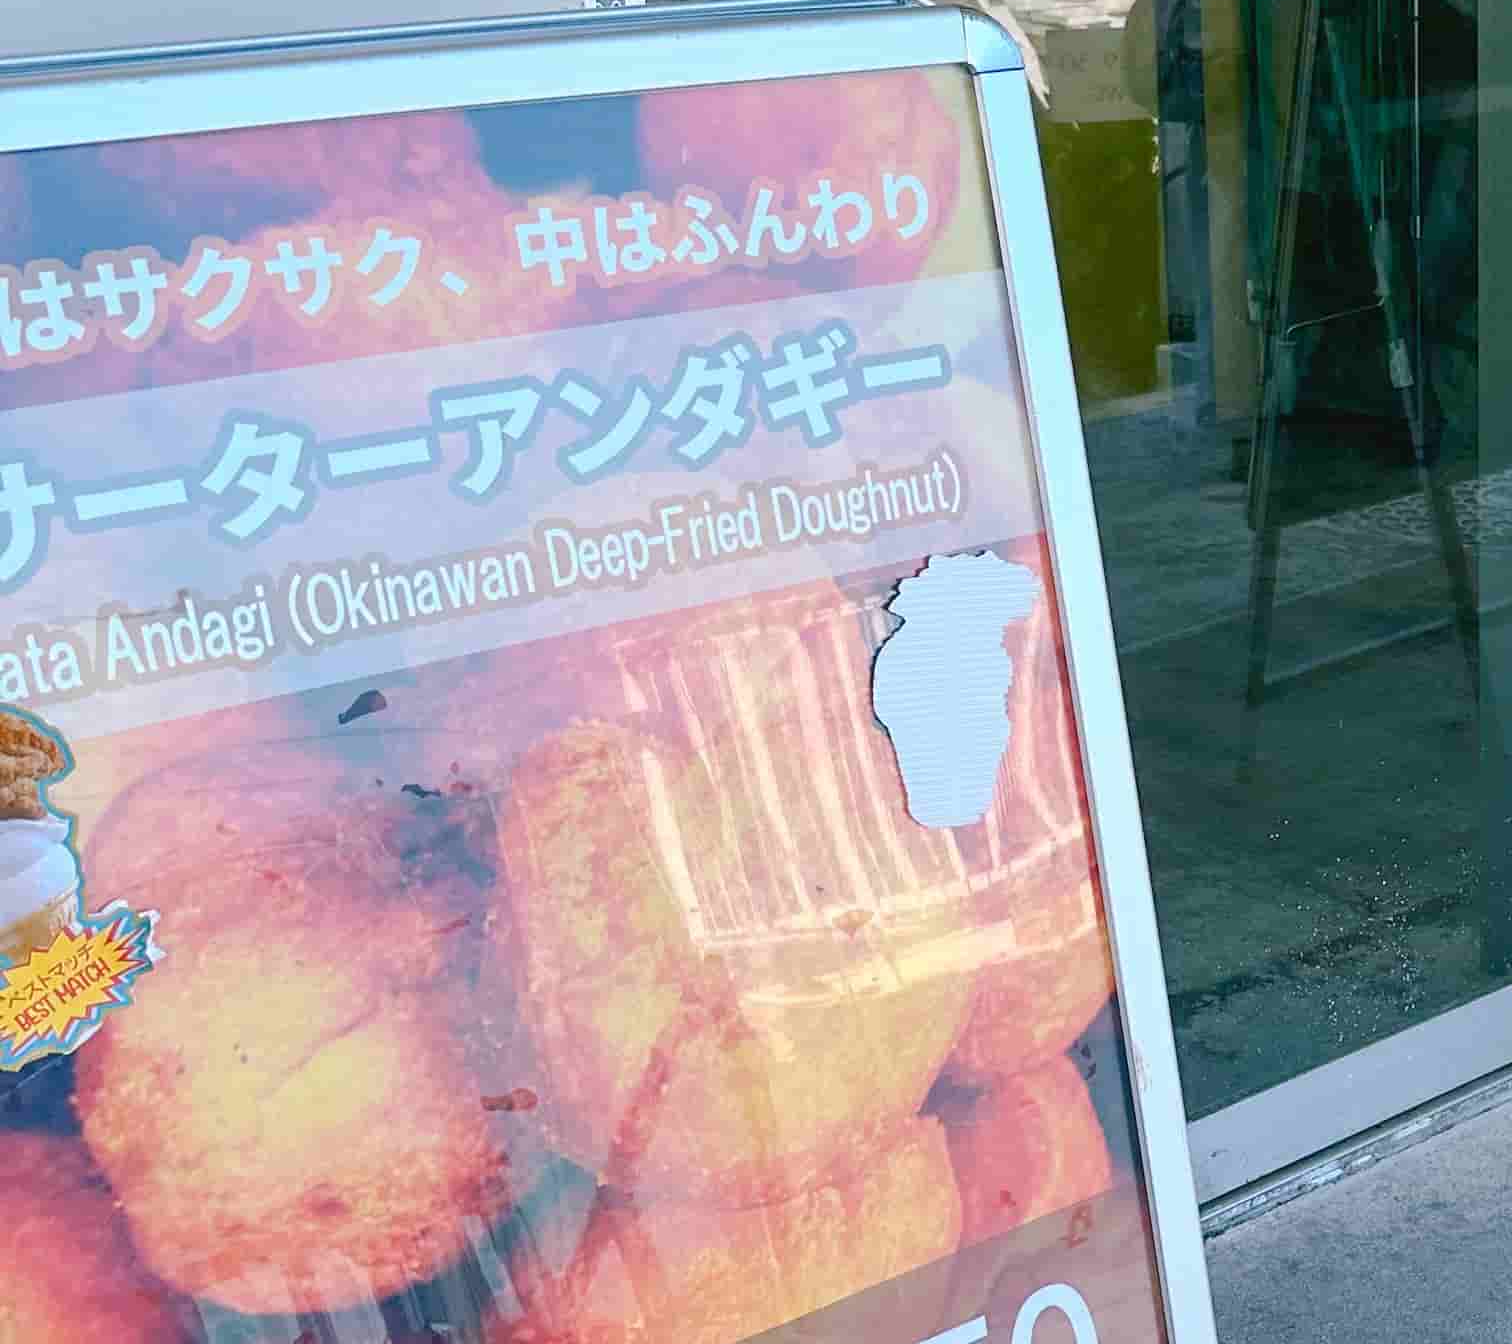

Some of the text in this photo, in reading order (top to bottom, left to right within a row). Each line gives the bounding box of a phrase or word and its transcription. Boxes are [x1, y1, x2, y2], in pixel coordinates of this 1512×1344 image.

[106, 584, 276, 682] Andagi
[288, 552, 536, 646] (Okinawan
[545, 493, 762, 588] Deep-Fried
[770, 452, 963, 556] Doughnut)
[9, 944, 94, 1009] ベストマッチ
[15, 957, 112, 1032] BEST MATCH
